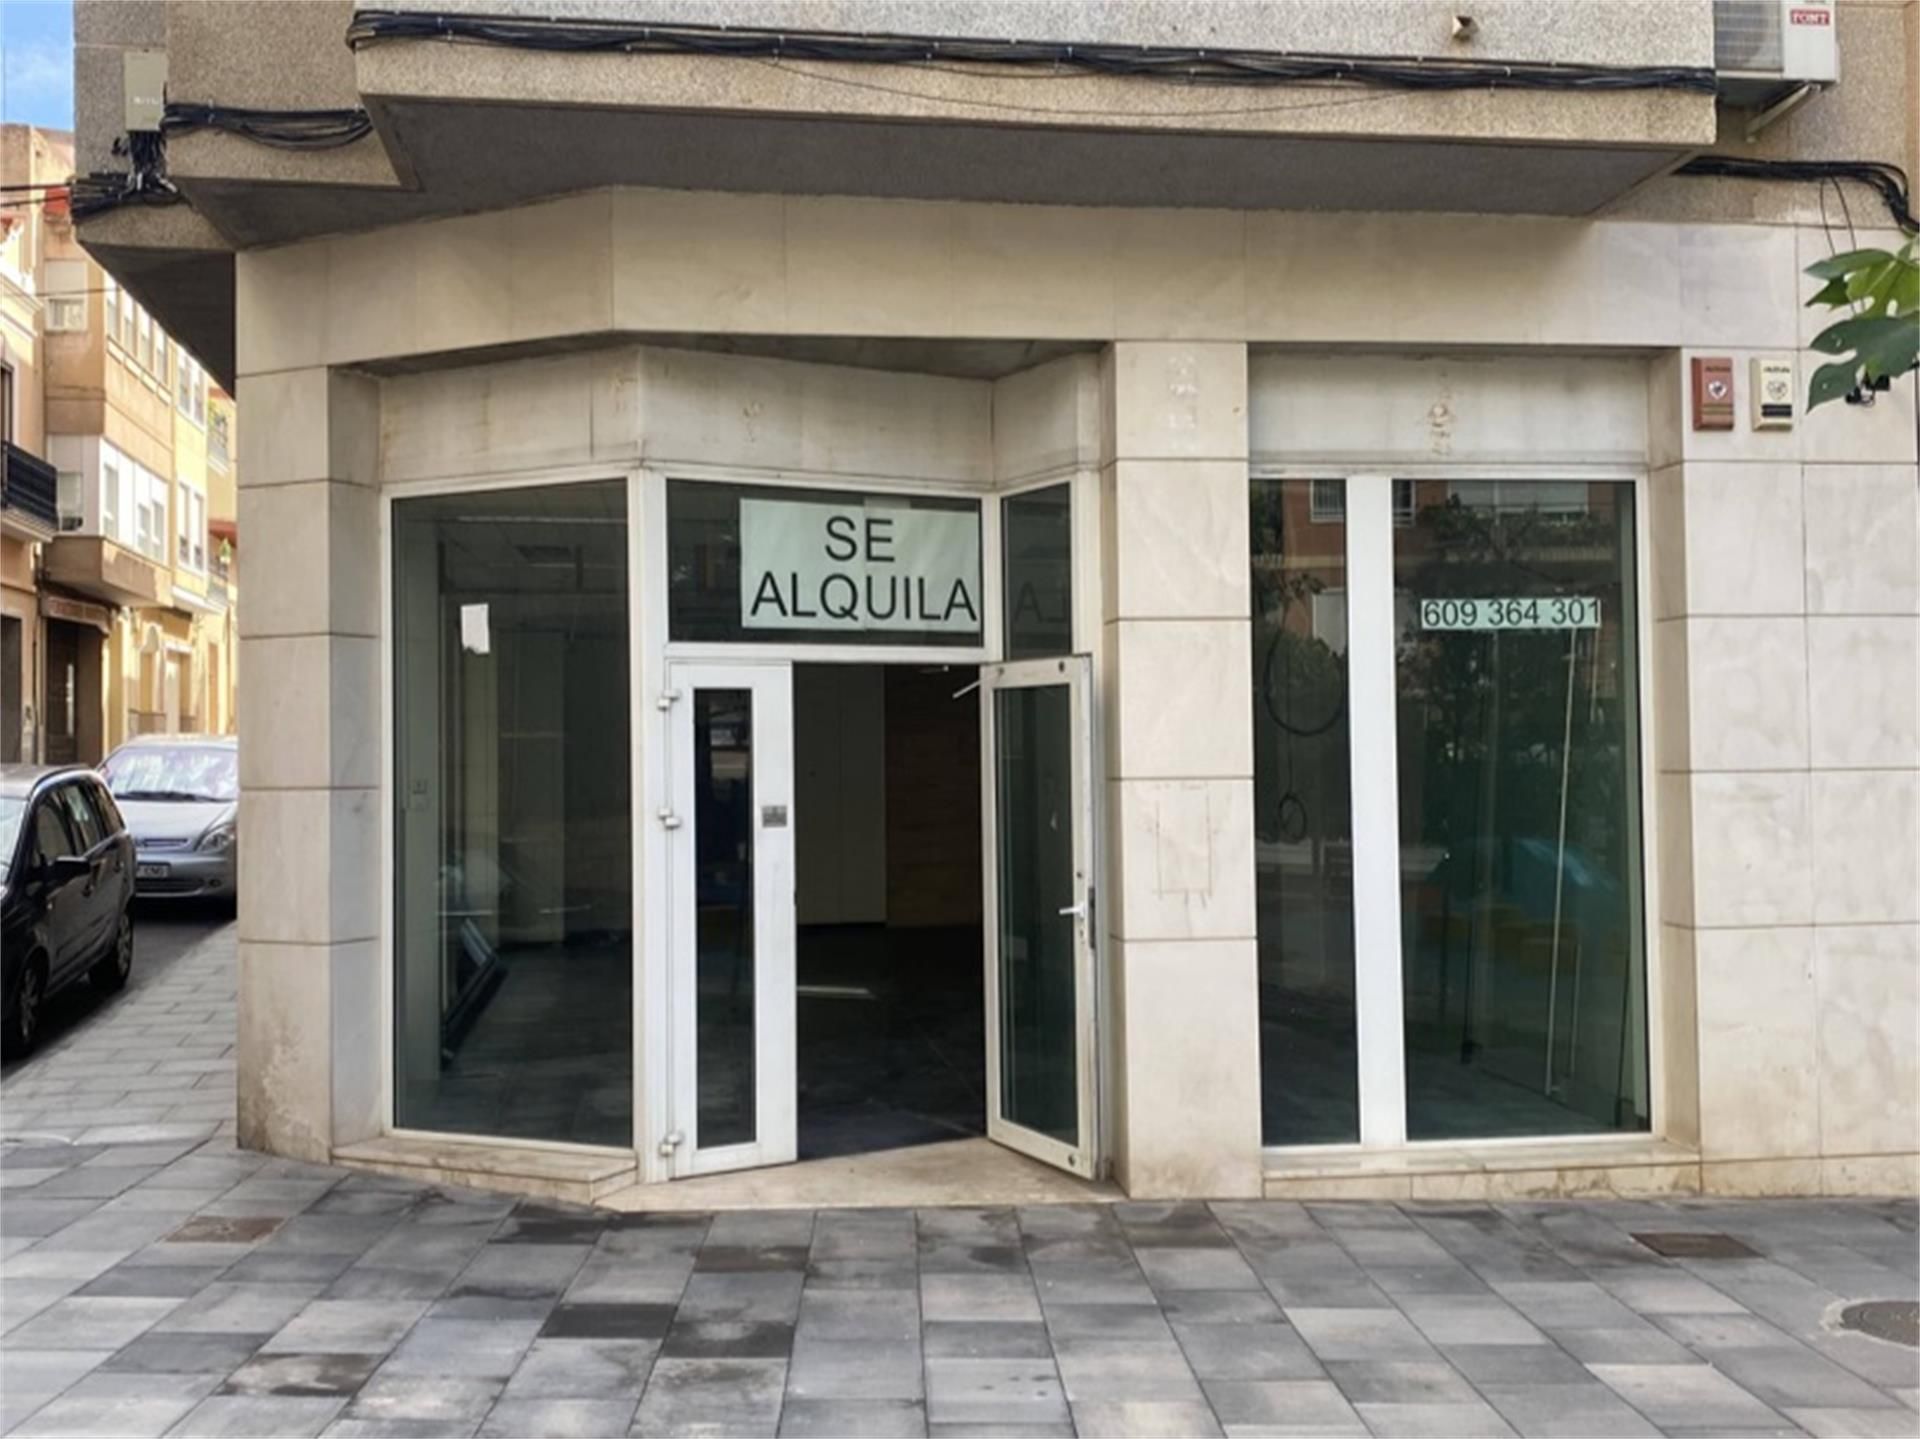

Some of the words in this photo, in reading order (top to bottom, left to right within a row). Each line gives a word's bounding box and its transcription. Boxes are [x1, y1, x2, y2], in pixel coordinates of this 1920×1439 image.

[825, 516, 895, 563] SE
[750, 571, 977, 621] ALQUILA
[1424, 600, 1478, 627] 609
[1488, 598, 1540, 626] 364
[1551, 598, 1600, 625] 301
